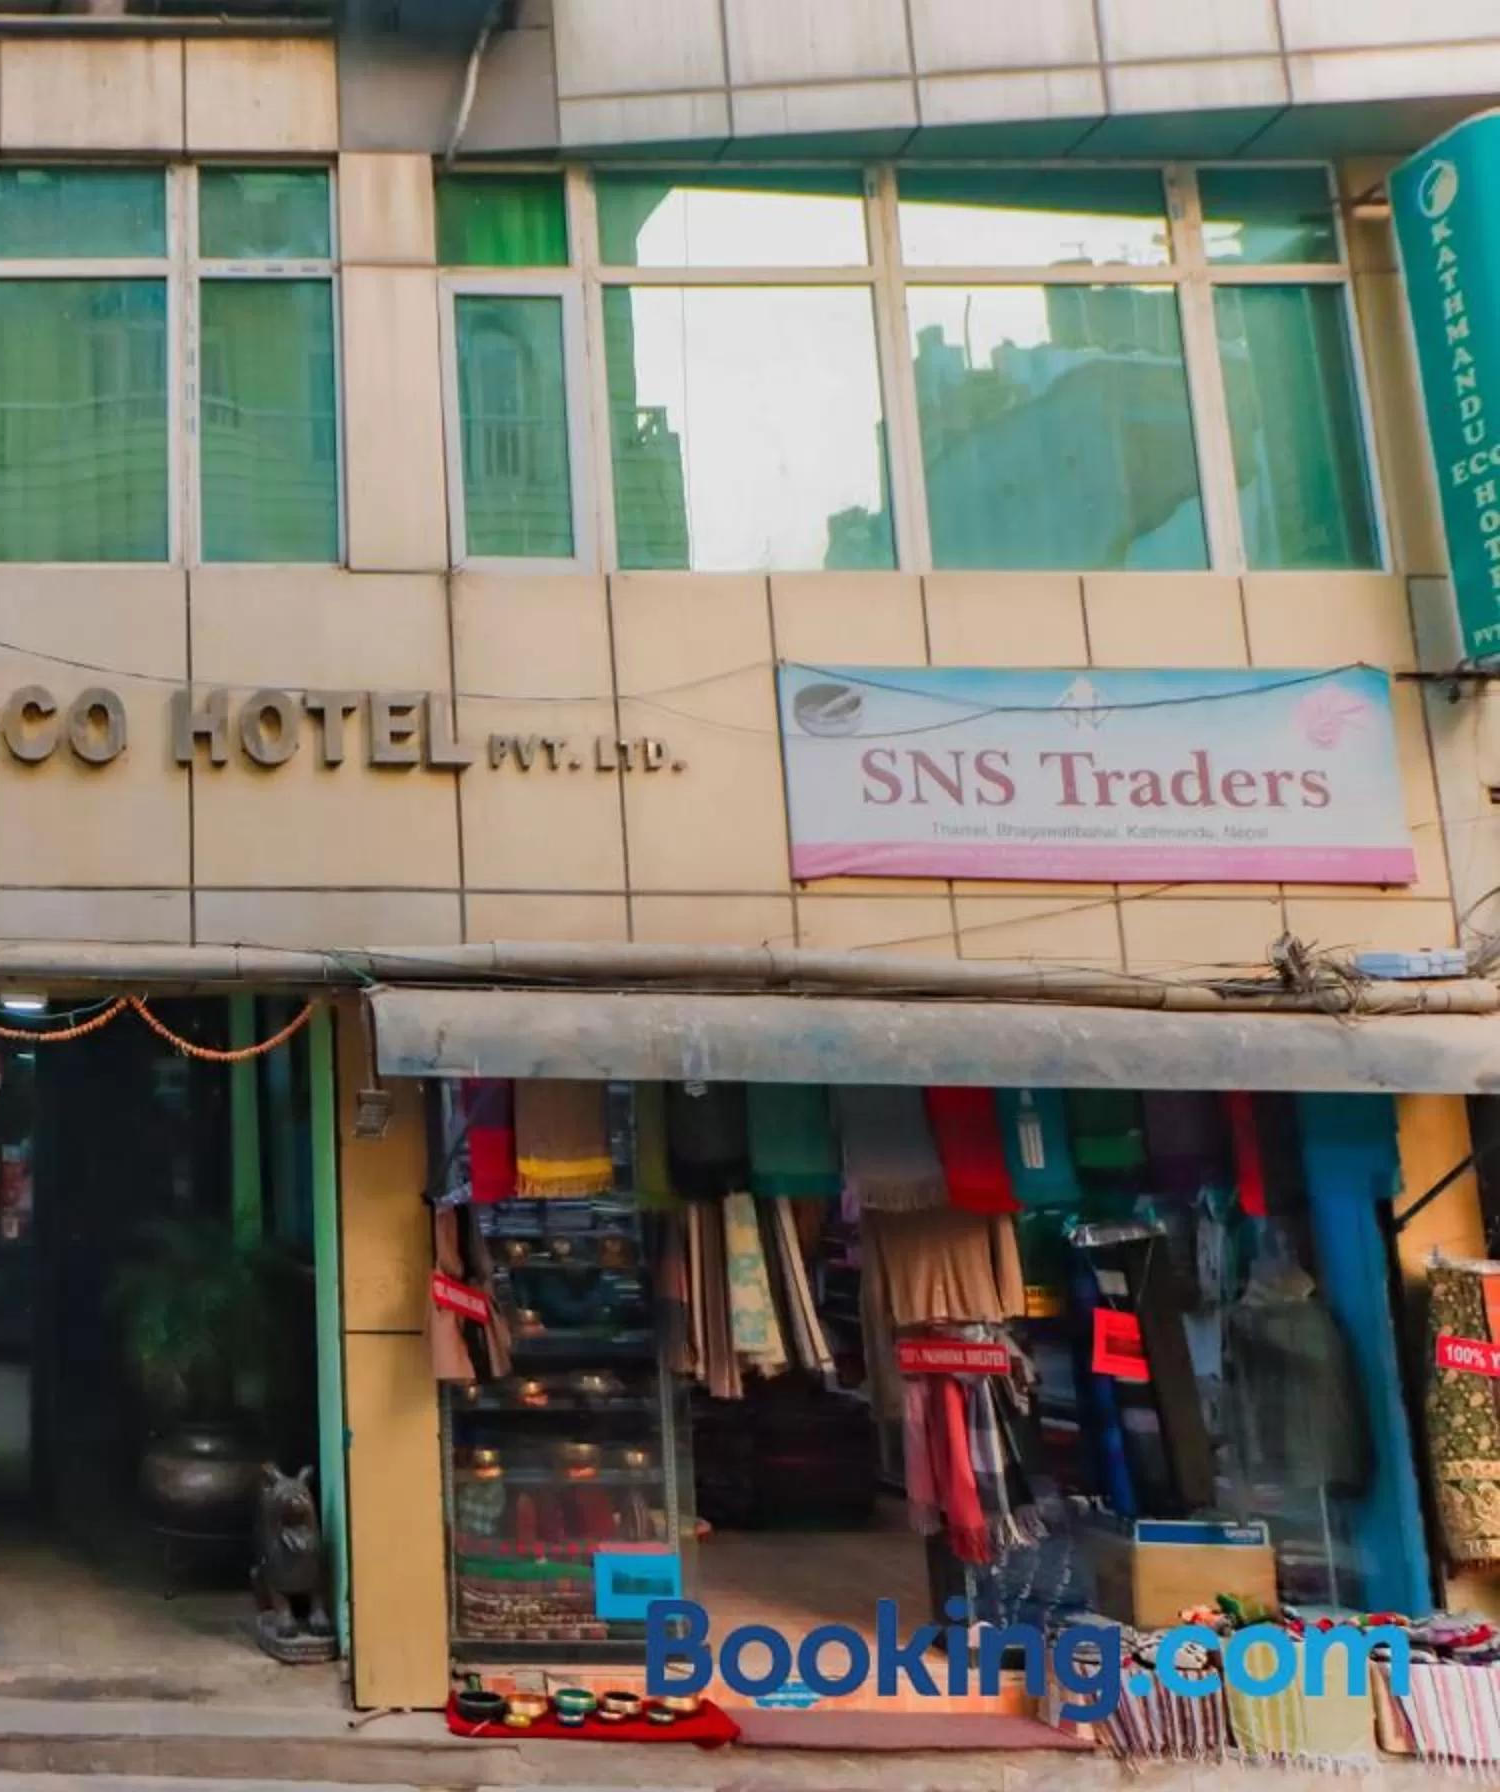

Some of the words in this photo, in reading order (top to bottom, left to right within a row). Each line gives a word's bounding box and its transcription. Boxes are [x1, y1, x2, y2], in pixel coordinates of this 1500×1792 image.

[1429, 216, 1486, 446] KATHMANDU
[171, 688, 472, 771] HOTEL
[487, 732, 581, 772] PVT.
[595, 735, 687, 773] LTD.
[860, 747, 1016, 807] SNS
[1039, 749, 1331, 809] Traders
[1445, 1343, 1487, 1369] 100%
